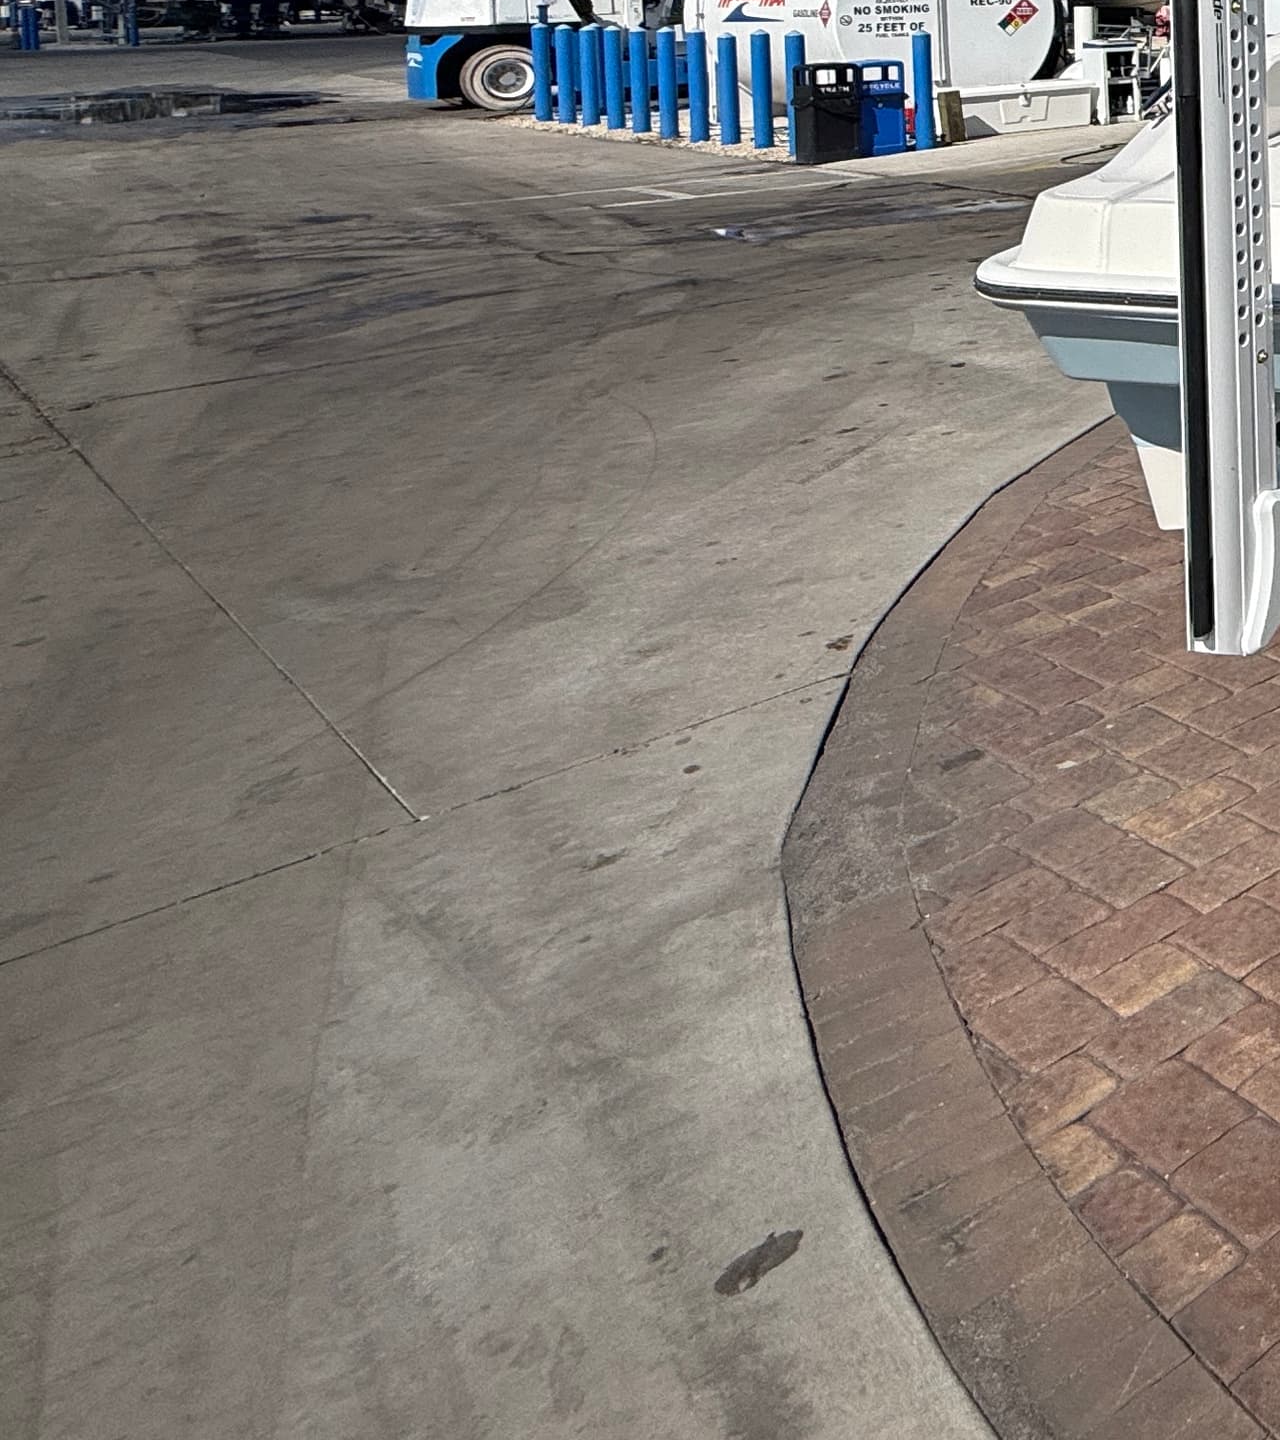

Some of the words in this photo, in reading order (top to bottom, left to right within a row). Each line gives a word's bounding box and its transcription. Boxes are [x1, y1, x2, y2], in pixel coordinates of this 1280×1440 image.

[793, 9, 818, 17] GASOLINE
[853, 6, 871, 15] NO
[875, 4, 930, 14] SMOKING
[858, 23, 872, 33] 25
[876, 22, 906, 32] FEET
[909, 22, 925, 31] OF
